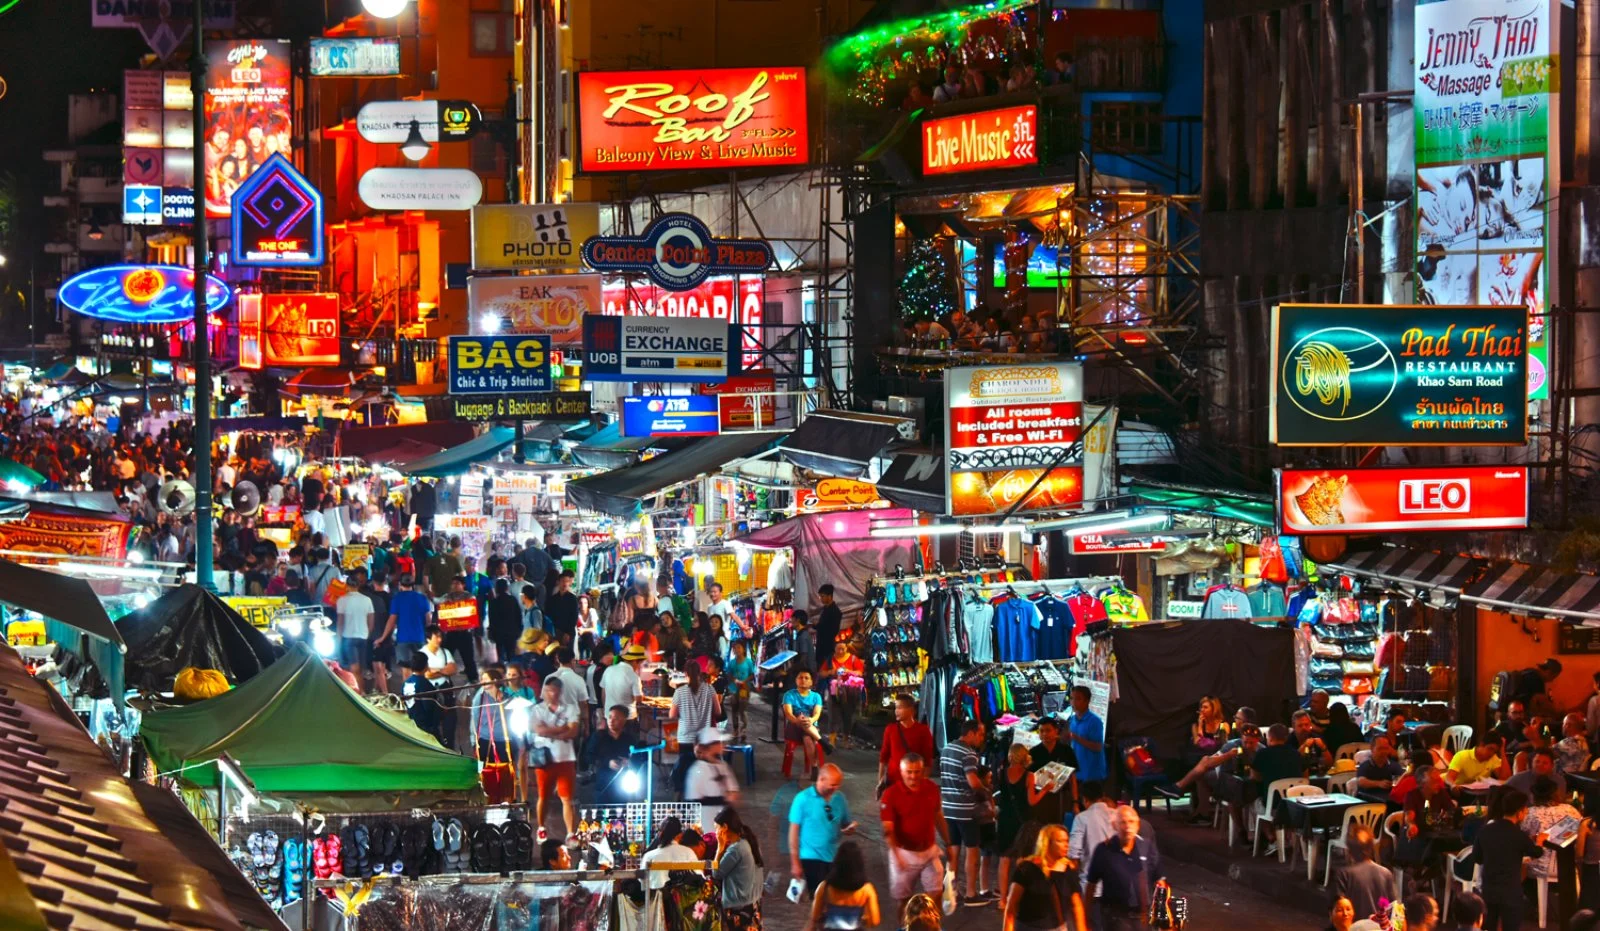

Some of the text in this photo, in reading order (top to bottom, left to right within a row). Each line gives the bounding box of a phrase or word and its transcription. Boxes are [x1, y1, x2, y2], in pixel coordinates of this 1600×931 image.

[1420, 15, 1538, 70] JENNY THAI
[234, 70, 259, 81] LEO
[1436, 75, 1491, 97] Massage
[602, 71, 770, 130] Roof
[1459, 102, 1483, 130] 按摩
[1490, 96, 1539, 119] マッサージ
[651, 117, 731, 144] Bar
[927, 117, 1011, 168] Live Music
[595, 142, 797, 166] Balcony View & Live Music
[163, 194, 195, 205] DOCTO
[163, 207, 195, 218] CLINI
[668, 219, 693, 229] HOTEL
[259, 241, 297, 251] THE ONE
[503, 242, 572, 257] PHOTO
[592, 242, 766, 265] Center Point Plaza
[652, 264, 708, 284] SHOPPING MALL
[520, 286, 553, 299] EAK
[309, 321, 335, 336] LEO
[626, 325, 670, 334] CURRENCY
[626, 336, 723, 351] EXCHANGE
[1400, 323, 1523, 357] Pad Thai
[457, 340, 544, 369] BAG
[590, 352, 618, 364] UOB
[640, 358, 660, 367] atm
[1405, 361, 1515, 373] RESTAURANT
[457, 375, 545, 389] Chic & Trip Station
[1417, 375, 1503, 387] Khao Sarn Road
[455, 397, 588, 420] Luggage & Backpack Center
[665, 401, 689, 411] ATM
[744, 396, 772, 408] AM
[1416, 396, 1504, 416] ร้านผัดไทย
[986, 406, 1052, 419] All rooms
[1017, 415, 1080, 429] breakfast
[1443, 416, 1508, 429] ถนนข้าวสาร
[976, 433, 987, 444] &
[992, 432, 1022, 443] Free
[819, 482, 874, 497] Center Point
[1404, 482, 1466, 511] LEO
[1170, 604, 1193, 614] ROOM
